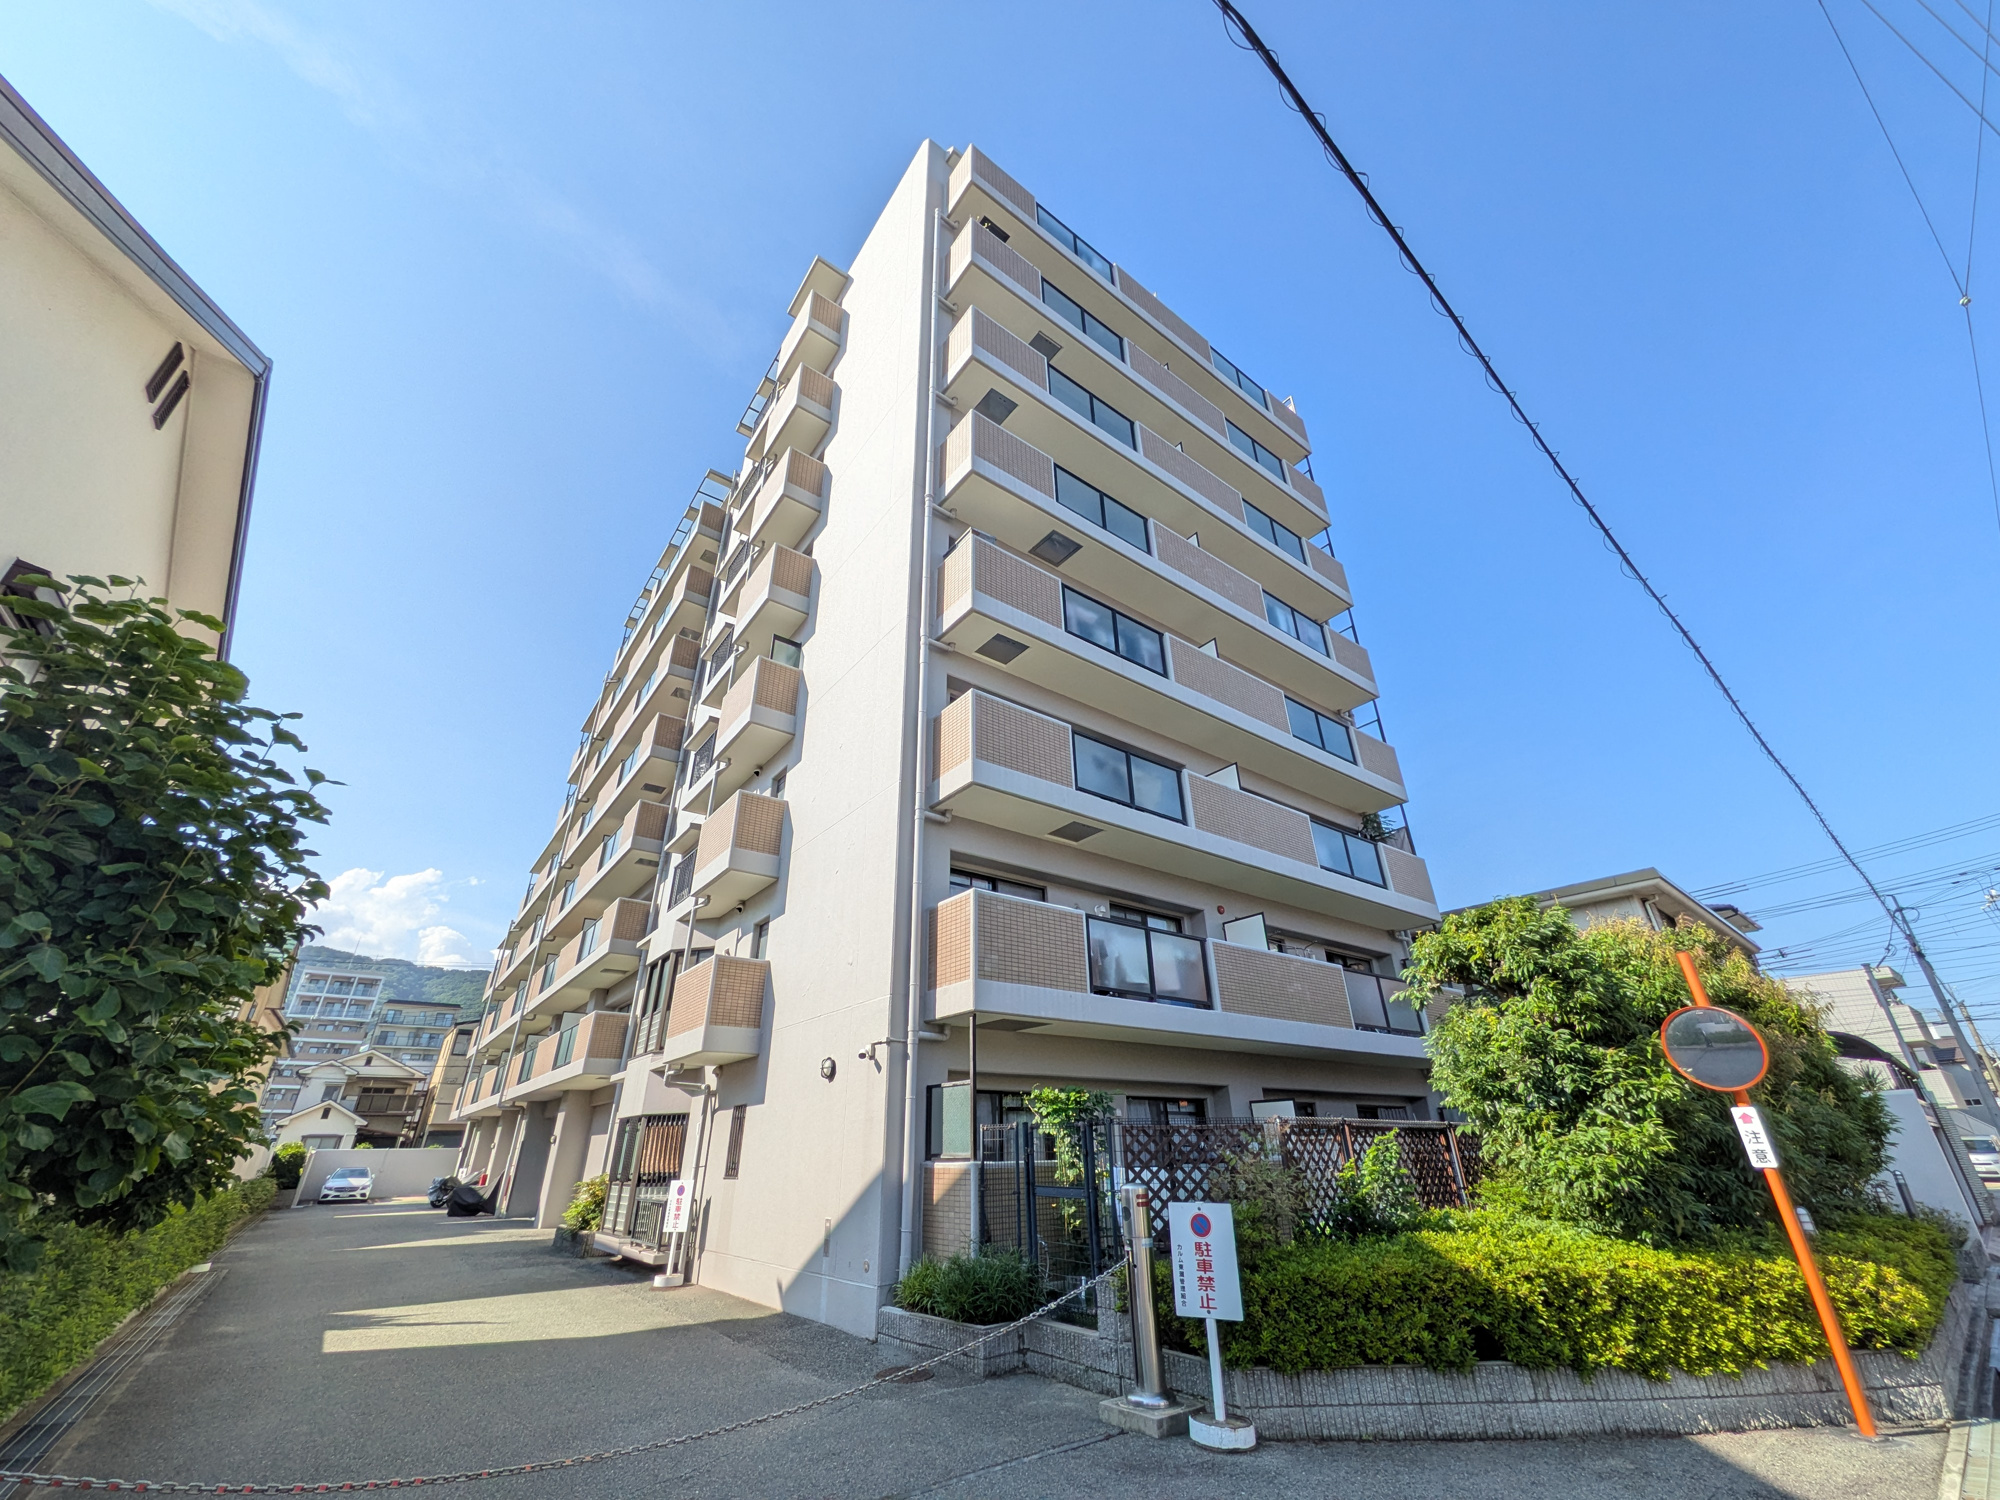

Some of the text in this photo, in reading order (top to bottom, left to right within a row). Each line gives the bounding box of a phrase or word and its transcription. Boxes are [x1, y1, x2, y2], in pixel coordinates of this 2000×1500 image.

[1744, 1130, 1771, 1164] 注意
[671, 1197, 683, 1229] 駐車禁止
[1194, 1241, 1218, 1310] 駐車禁止
